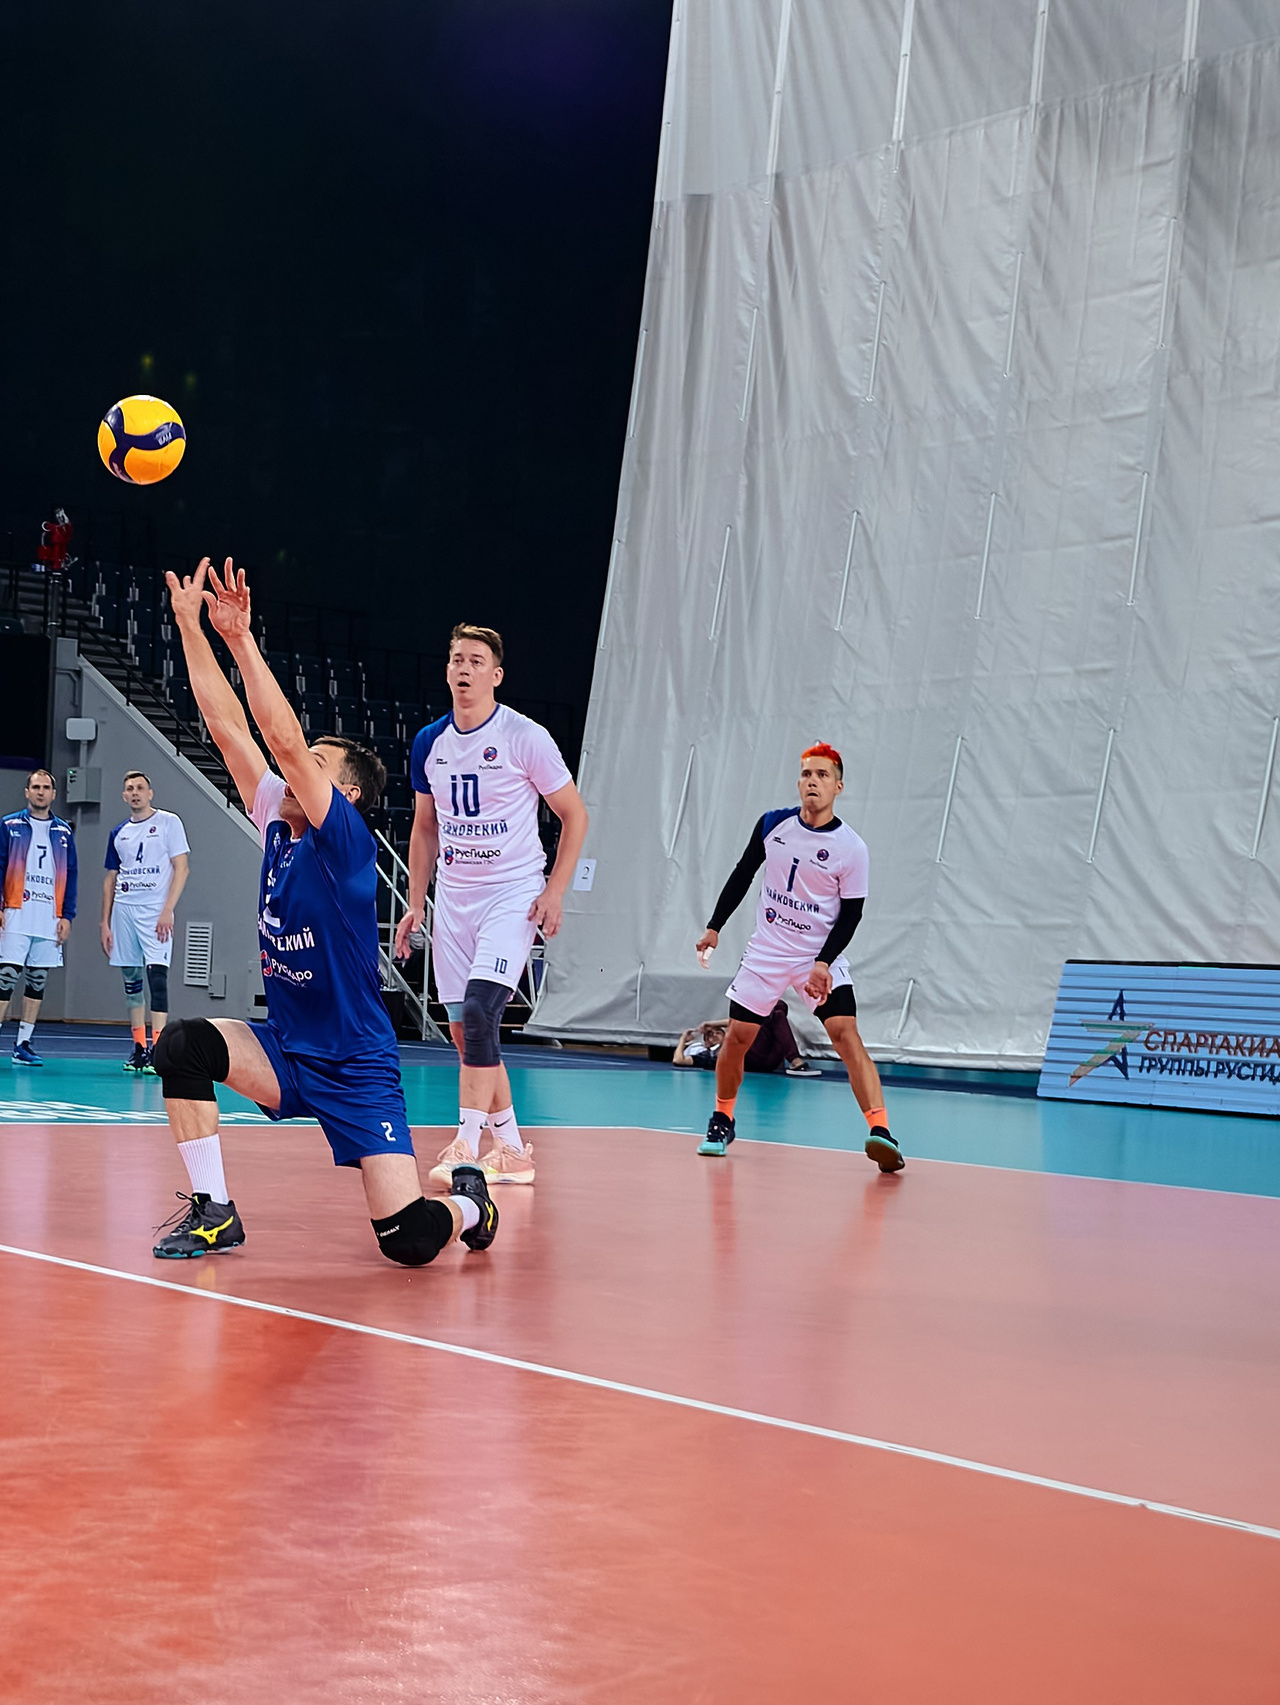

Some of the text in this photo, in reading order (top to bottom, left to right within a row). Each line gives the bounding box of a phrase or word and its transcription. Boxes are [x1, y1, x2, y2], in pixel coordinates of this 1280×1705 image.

[450, 774, 480, 817] 10
[36, 845, 47, 869] 7
[135, 842, 143, 864] 4
[455, 848, 501, 860] РусГидро
[581, 866, 590, 880] 2
[494, 957, 508, 974] 10
[380, 1121, 397, 1142] 2
